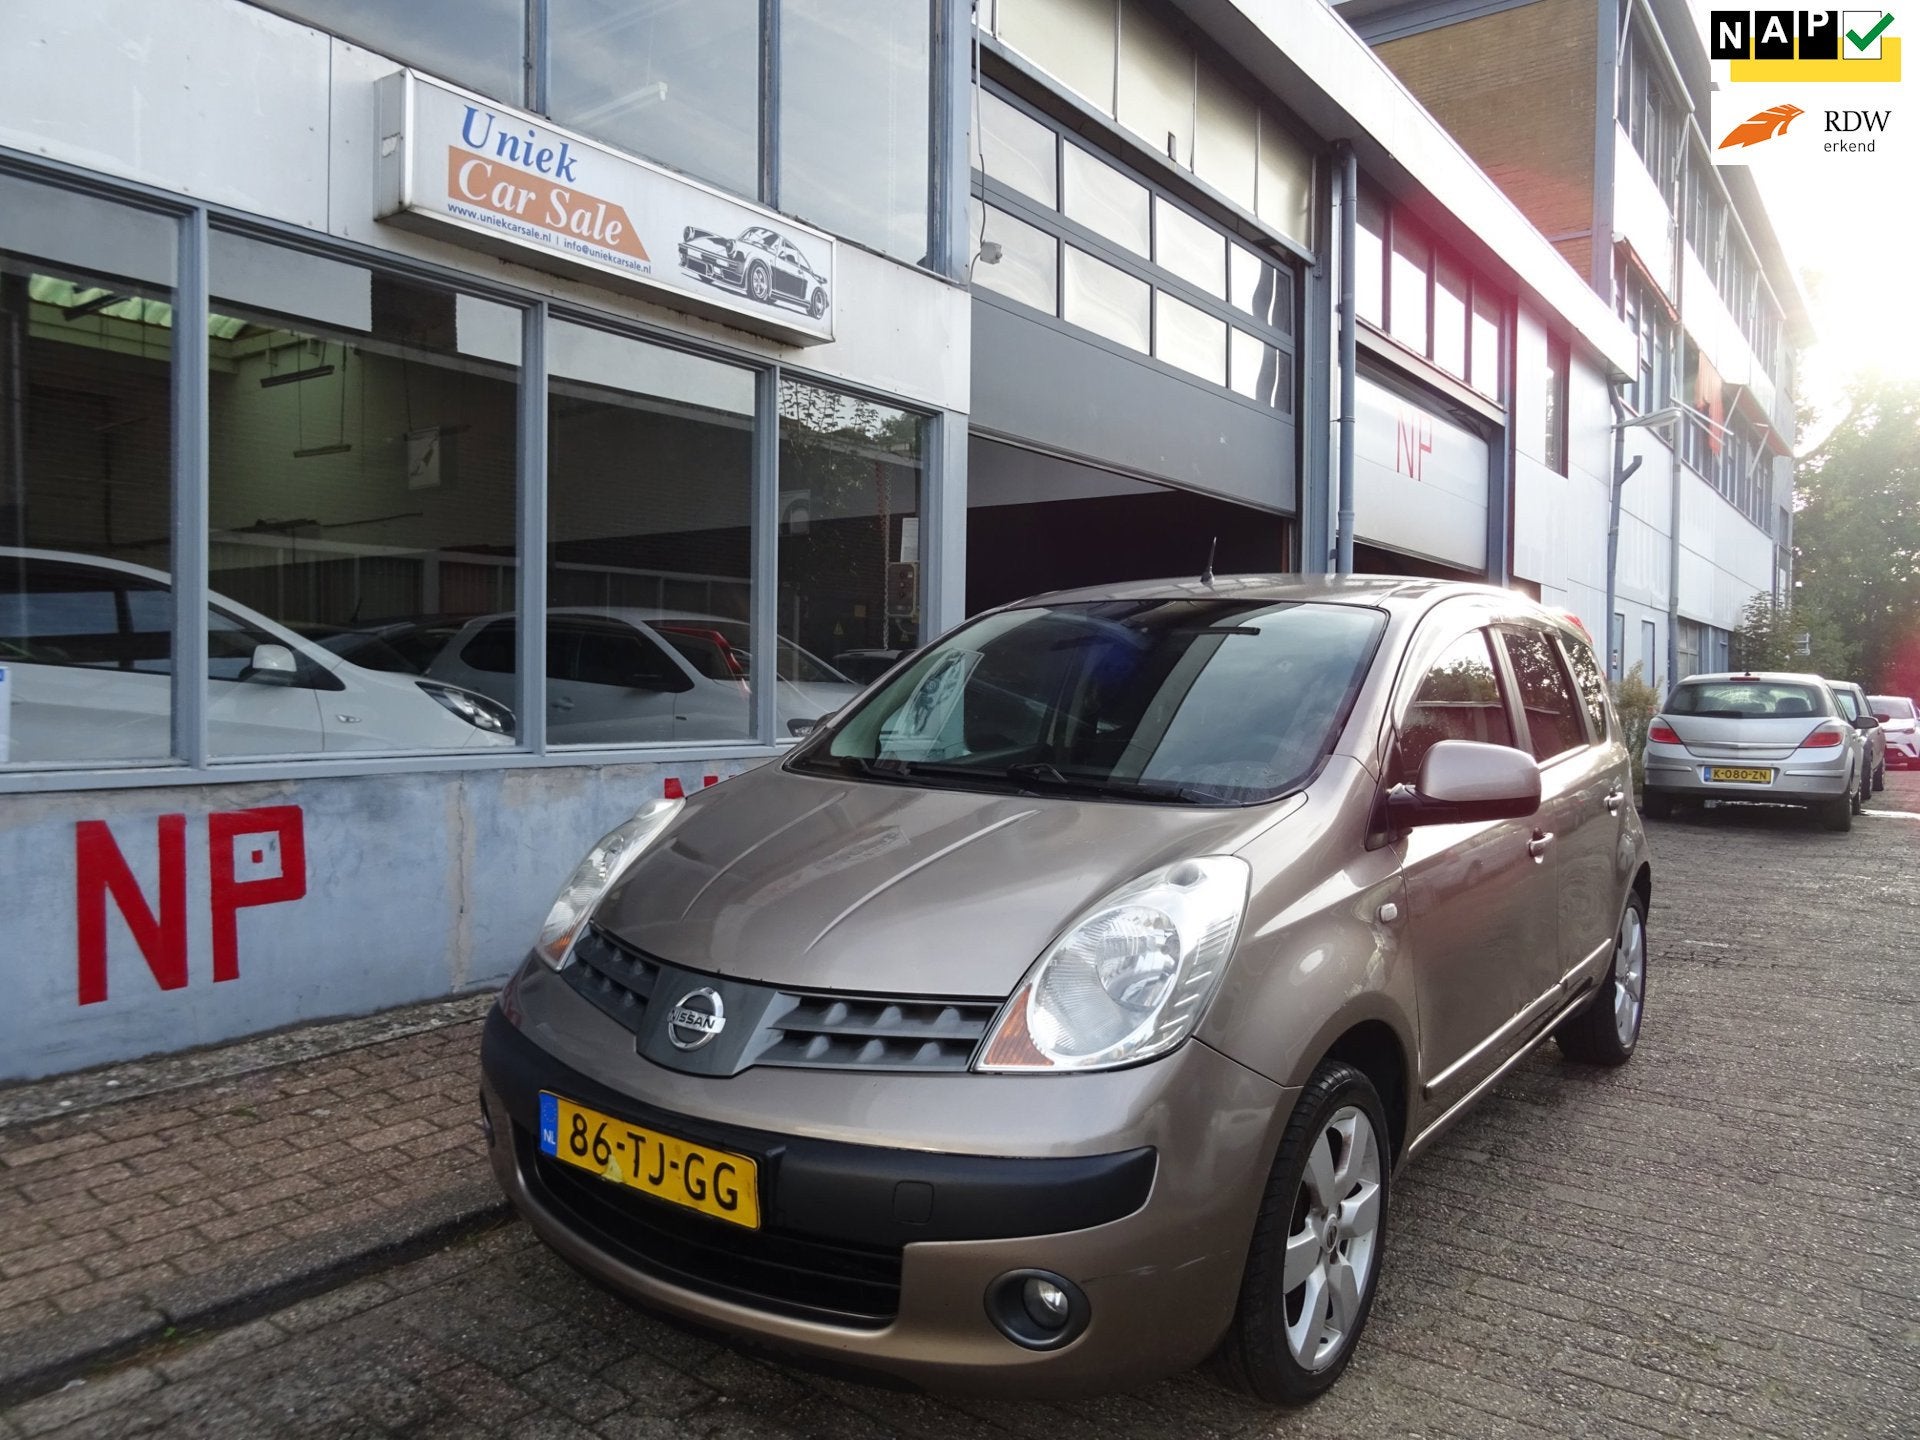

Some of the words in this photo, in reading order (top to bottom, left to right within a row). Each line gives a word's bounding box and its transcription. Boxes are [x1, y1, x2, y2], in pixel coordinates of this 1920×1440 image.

[462, 106, 576, 182] Uniek
[448, 203, 552, 243] www.uniekcarsale.nl
[564, 237, 652, 275] info@uniekcarsale.nl
[459, 160, 536, 214] Car
[546, 189, 622, 245] Sale
[1713, 769, 1767, 780] K-080-ZN
[76, 805, 307, 1006] NP
[671, 1009, 716, 1029] NISSAN
[569, 1112, 738, 1212] 86-TJ-GG
